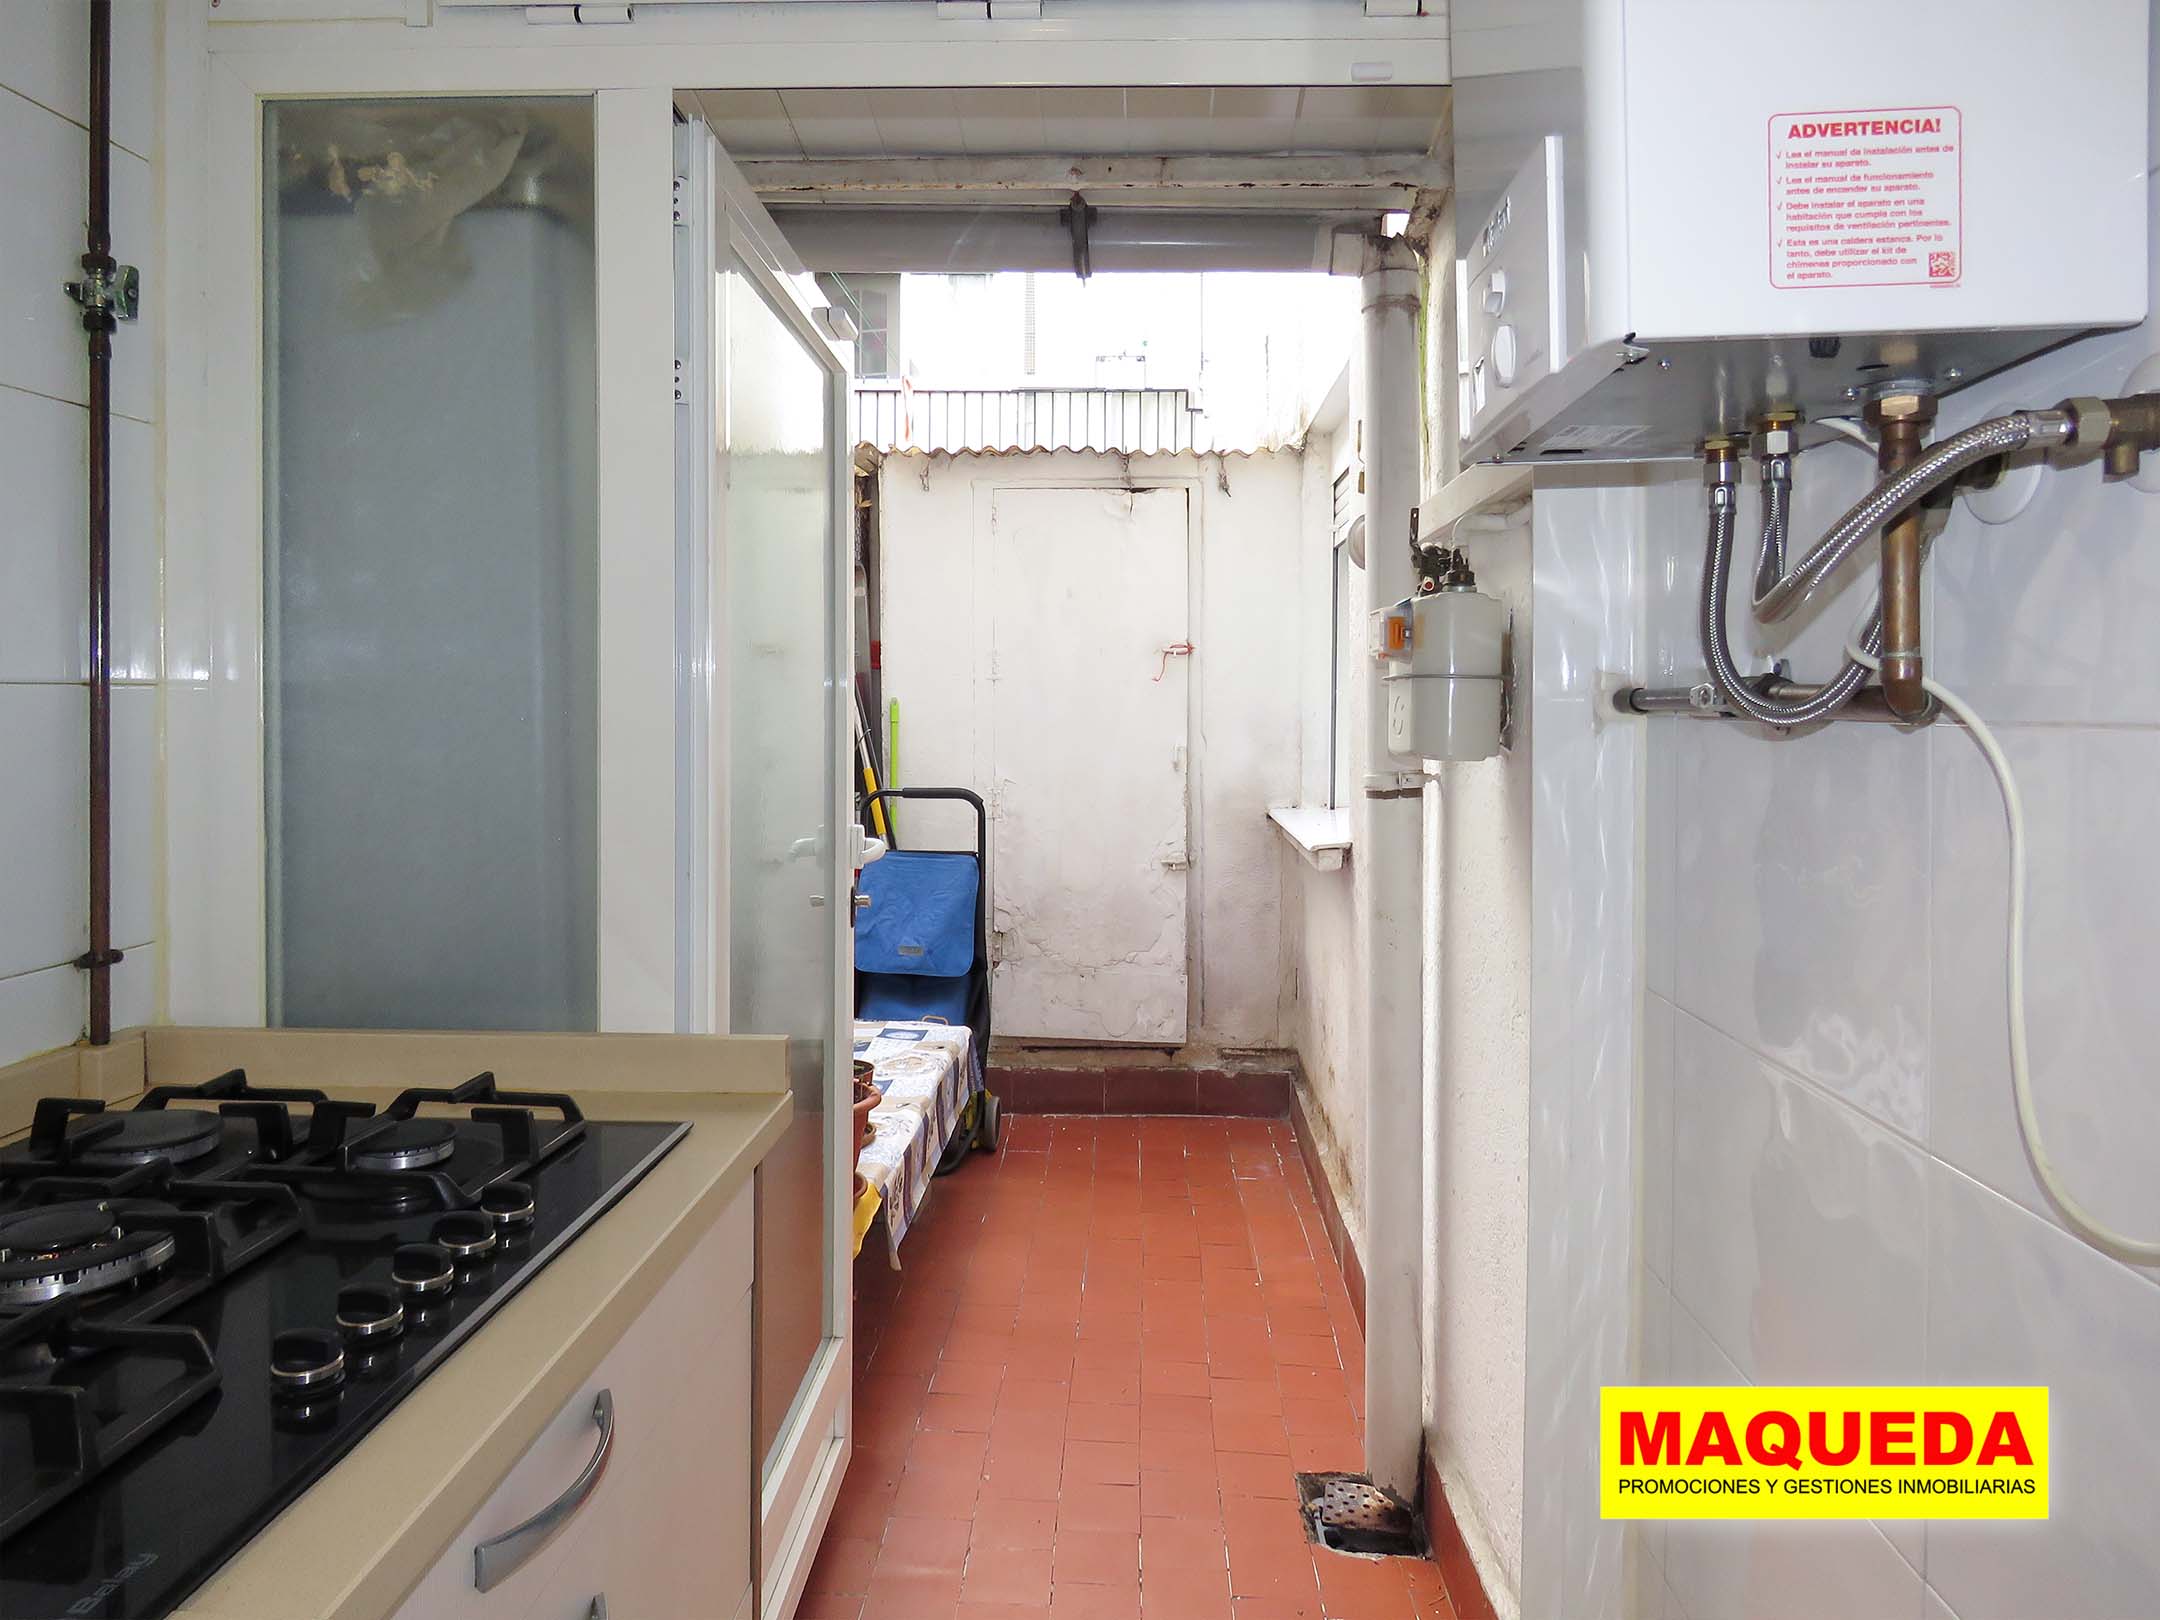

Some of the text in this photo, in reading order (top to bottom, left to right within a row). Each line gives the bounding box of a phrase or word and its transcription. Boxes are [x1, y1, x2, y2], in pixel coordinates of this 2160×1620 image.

[1788, 118, 1941, 139] ADVERTENCIA!
[1786, 151, 1802, 159] Lea
[1804, 150, 1812, 158] el
[1815, 149, 1847, 157] manual
[1850, 148, 1861, 156] de
[1815, 174, 1847, 182] manual
[1850, 173, 1861, 181] de
[1786, 202, 1809, 210] Debe
[1811, 200, 1844, 209] instalar
[1847, 200, 1855, 208] el
[1857, 200, 1891, 208] aparato
[1894, 199, 1905, 207] en
[1835, 213, 1852, 221] que
[1786, 224, 1831, 233] requisitos
[1786, 239, 1806, 247] Esta
[1916, 234, 1932, 242] Por
[1814, 249, 1836, 257] debe
[1839, 247, 1869, 256] utilizar
[1871, 247, 1880, 255] el
[1882, 246, 1893, 254] kit
[1895, 246, 1907, 254] de
[1832, 257, 1898, 268] proporcionado
[1786, 271, 1833, 280] el aparato.
